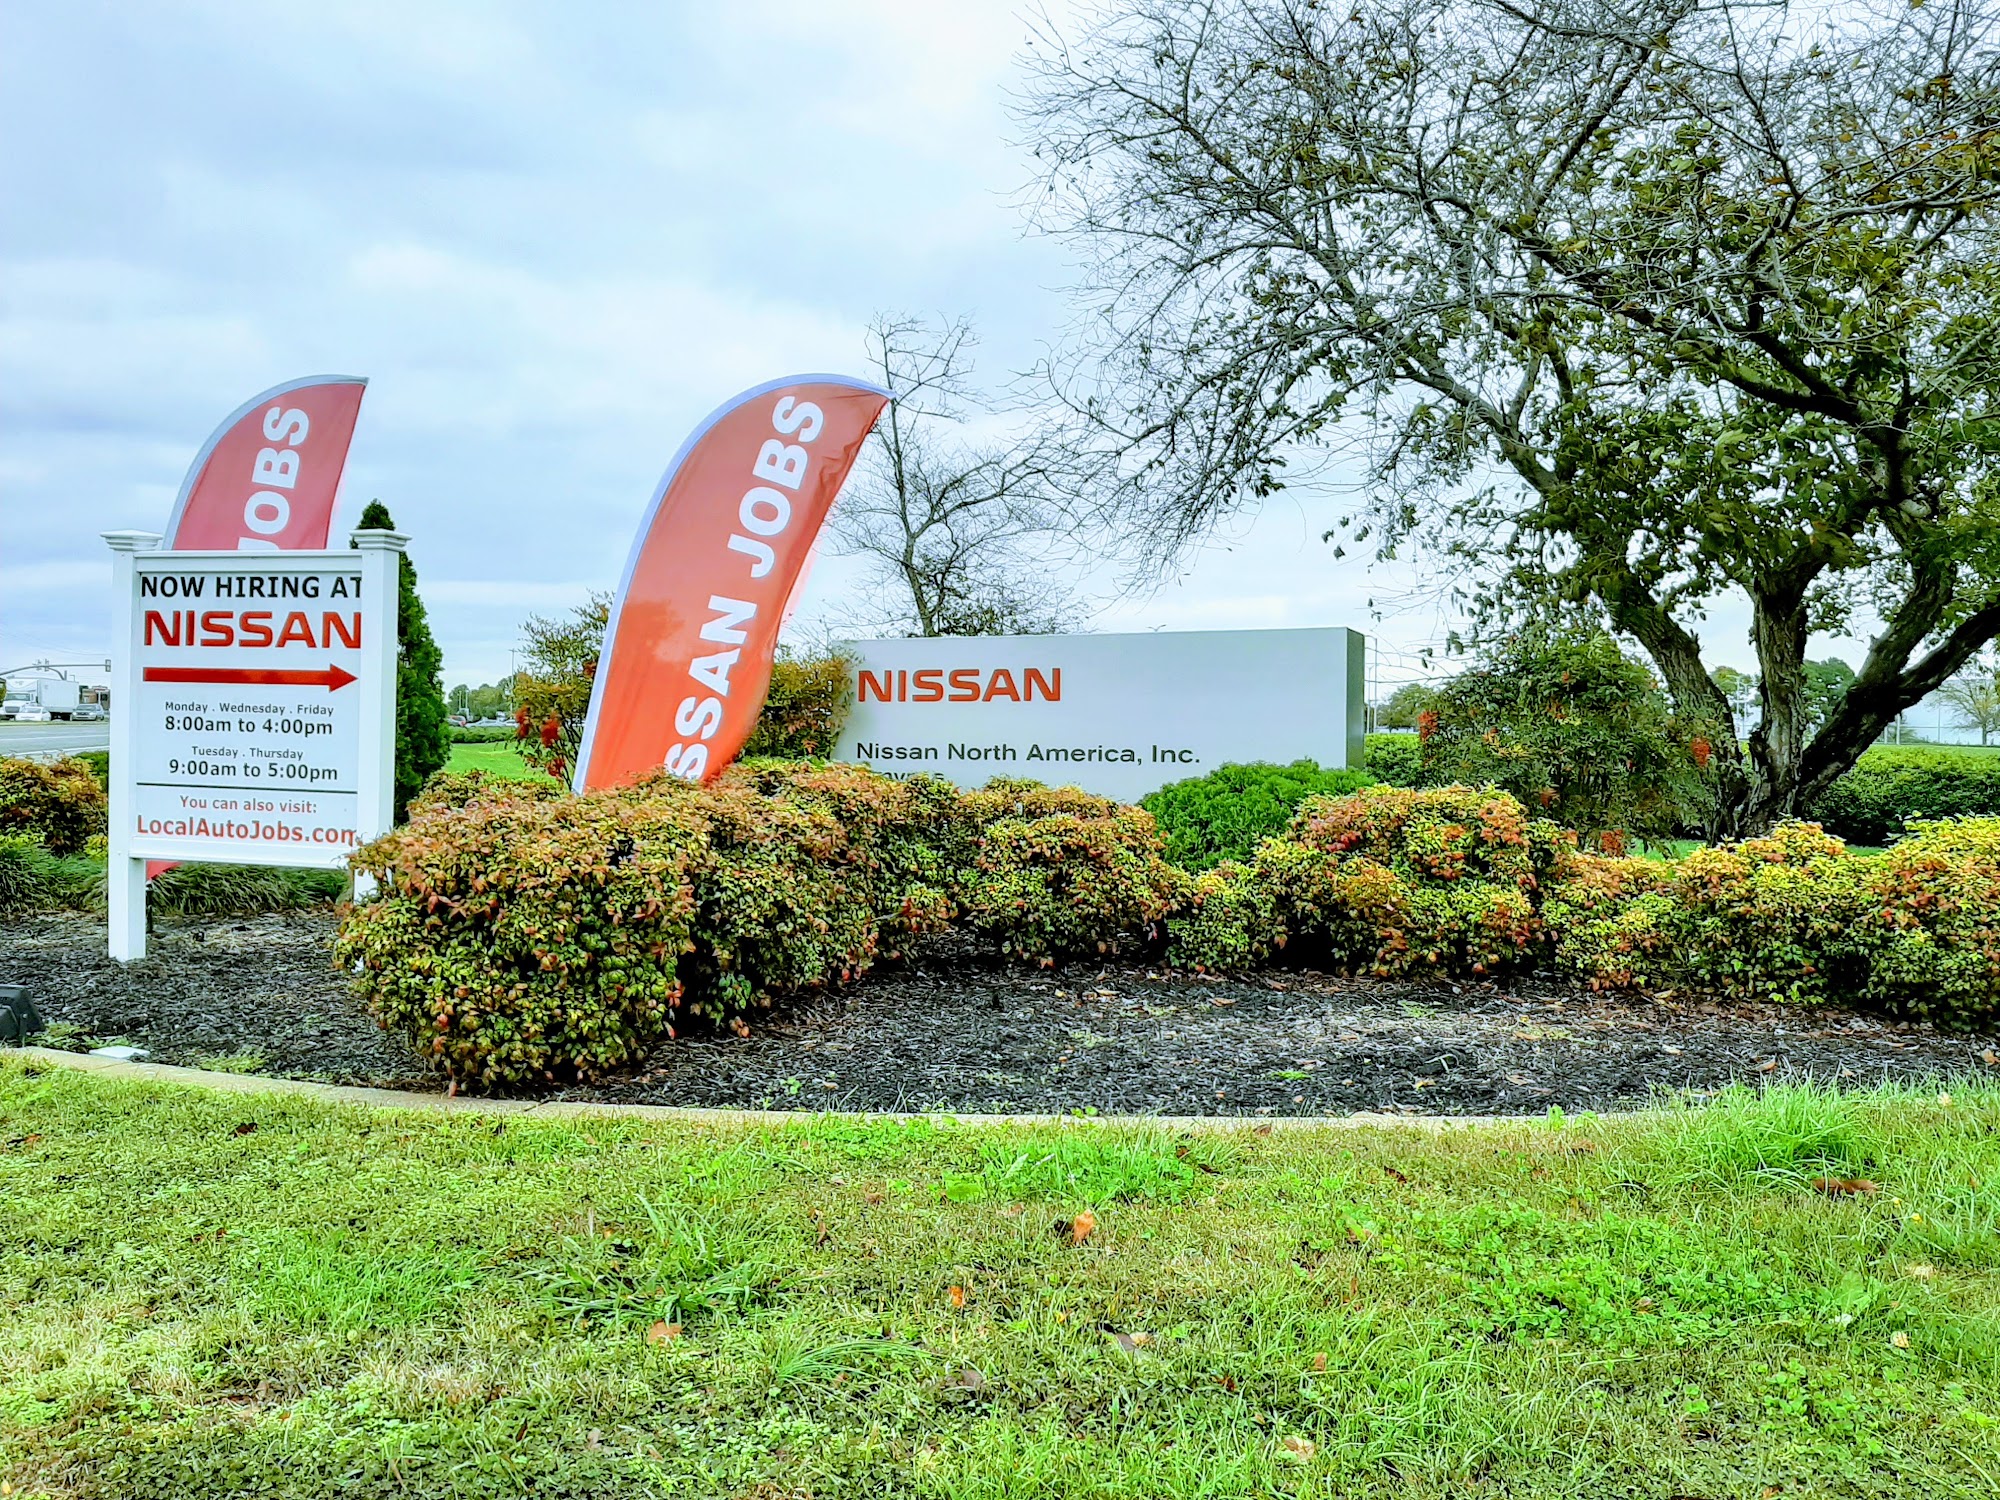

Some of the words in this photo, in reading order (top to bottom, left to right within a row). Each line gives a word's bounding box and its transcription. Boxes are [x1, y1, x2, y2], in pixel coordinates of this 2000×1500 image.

[728, 396, 824, 578] JOBS
[141, 576, 205, 598] NOW
[215, 576, 320, 598] HIRING
[330, 576, 362, 598] AT
[143, 610, 362, 649] NISSAN
[857, 668, 1061, 702] NISSAN
[165, 701, 208, 714] Monday
[219, 702, 286, 716] Wednesday
[297, 704, 334, 718] Friday
[164, 715, 232, 732] 8:00am
[238, 718, 256, 733] to
[262, 718, 333, 739] 4:00pm
[191, 745, 238, 759] Tuesday
[249, 747, 304, 761] Thursday
[857, 742, 938, 760] Nissan
[948, 743, 1017, 761] North
[1026, 743, 1142, 765] America,
[1152, 744, 1200, 764] Inc.
[169, 759, 237, 776] 9:00am
[243, 762, 261, 778] to
[268, 763, 338, 782] 5:00pm
[179, 795, 207, 809] You
[212, 799, 238, 810] can
[244, 798, 274, 812] also
[279, 799, 317, 814] visit:
